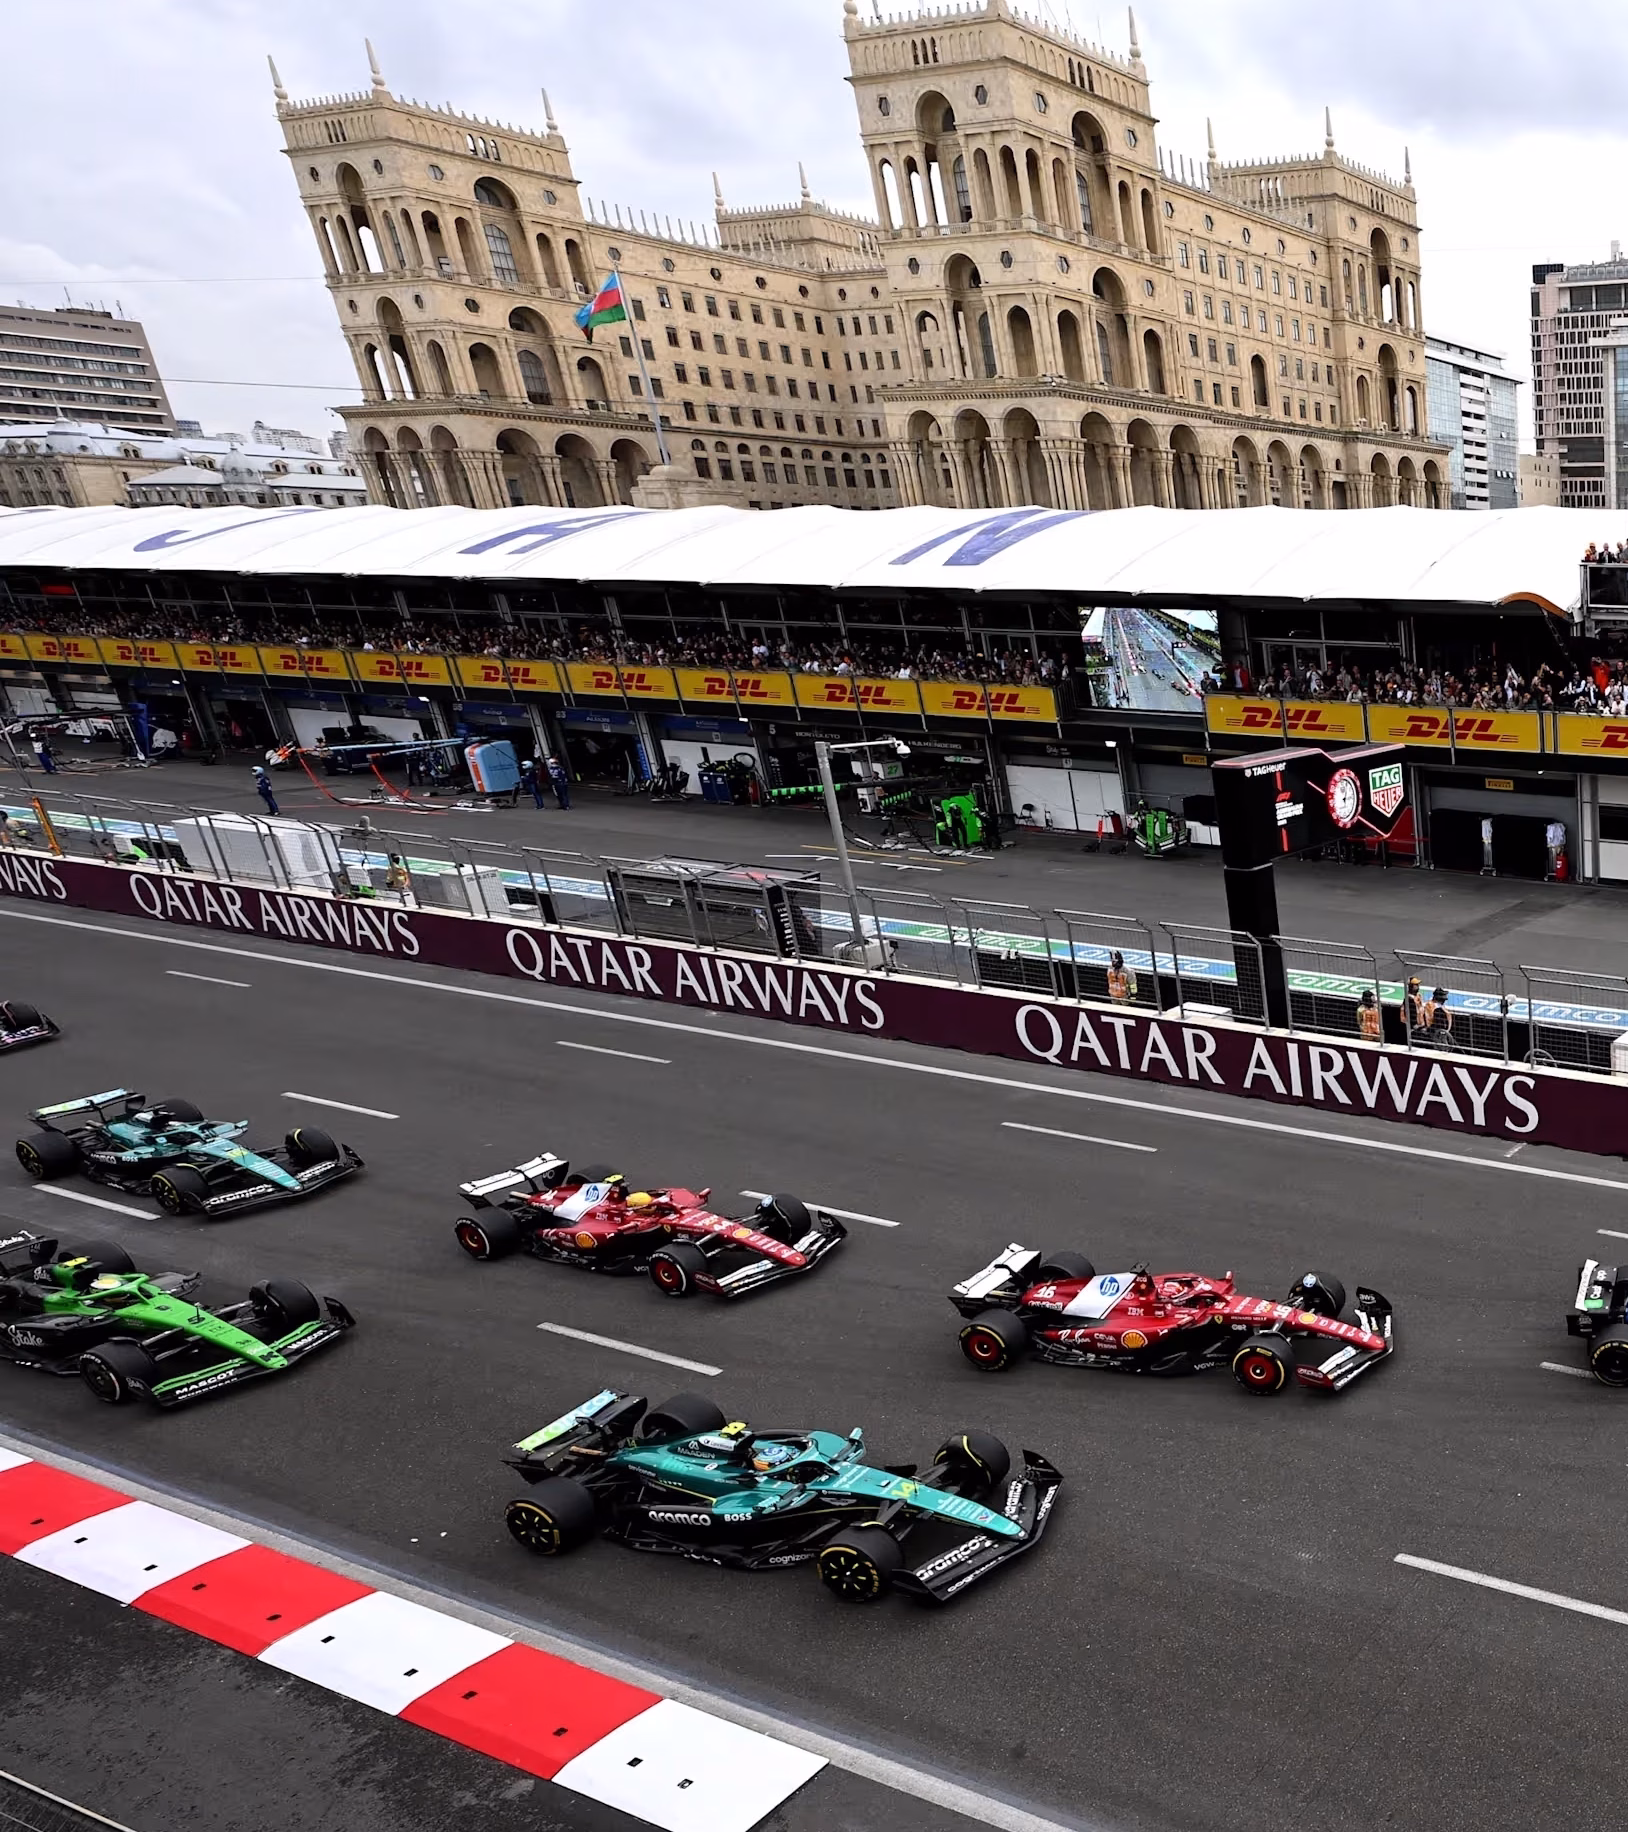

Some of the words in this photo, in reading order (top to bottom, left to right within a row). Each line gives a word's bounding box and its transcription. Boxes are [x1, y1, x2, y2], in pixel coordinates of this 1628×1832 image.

[42, 642, 85, 658] DHL
[117, 646, 160, 662] DHL
[196, 650, 243, 668] DHL
[280, 654, 330, 673] DHL
[376, 660, 430, 679] DHL
[481, 665, 538, 685] DHL
[592, 671, 653, 692] DHL
[704, 677, 769, 698] DHL
[824, 684, 893, 706] DHL
[952, 690, 1027, 713] DHL
[769, 724, 776, 734] 5
[1241, 706, 1330, 731] DHL
[1406, 715, 1501, 742] DHL
[1371, 769, 1401, 788] TAG
[1373, 786, 1402, 813] HEUER
[0, 852, 67, 900] WAYS
[129, 873, 253, 930] QATAR
[260, 896, 421, 956] AIRWAYS
[505, 928, 664, 996] QATAR
[675, 952, 886, 1031] AIRWAYS
[1288, 971, 1396, 997] amco
[1462, 997, 1623, 1023] aramco
[1015, 1003, 1226, 1085] QATAR
[1243, 1036, 1540, 1133] AIRWAYS
[210, 1184, 268, 1205] aramco
[1033, 1285, 1058, 1299] 16
[1102, 1275, 1119, 1297] hp
[1127, 1306, 1144, 1317] IBM
[1272, 1305, 1293, 1319] 16
[7, 1324, 44, 1347] Stake
[1193, 1361, 1215, 1371] VGW
[175, 1368, 236, 1396] MASCOT
[648, 1510, 712, 1527] aramco
[724, 1513, 752, 1523] BOSS
[915, 1535, 986, 1582] aramco
